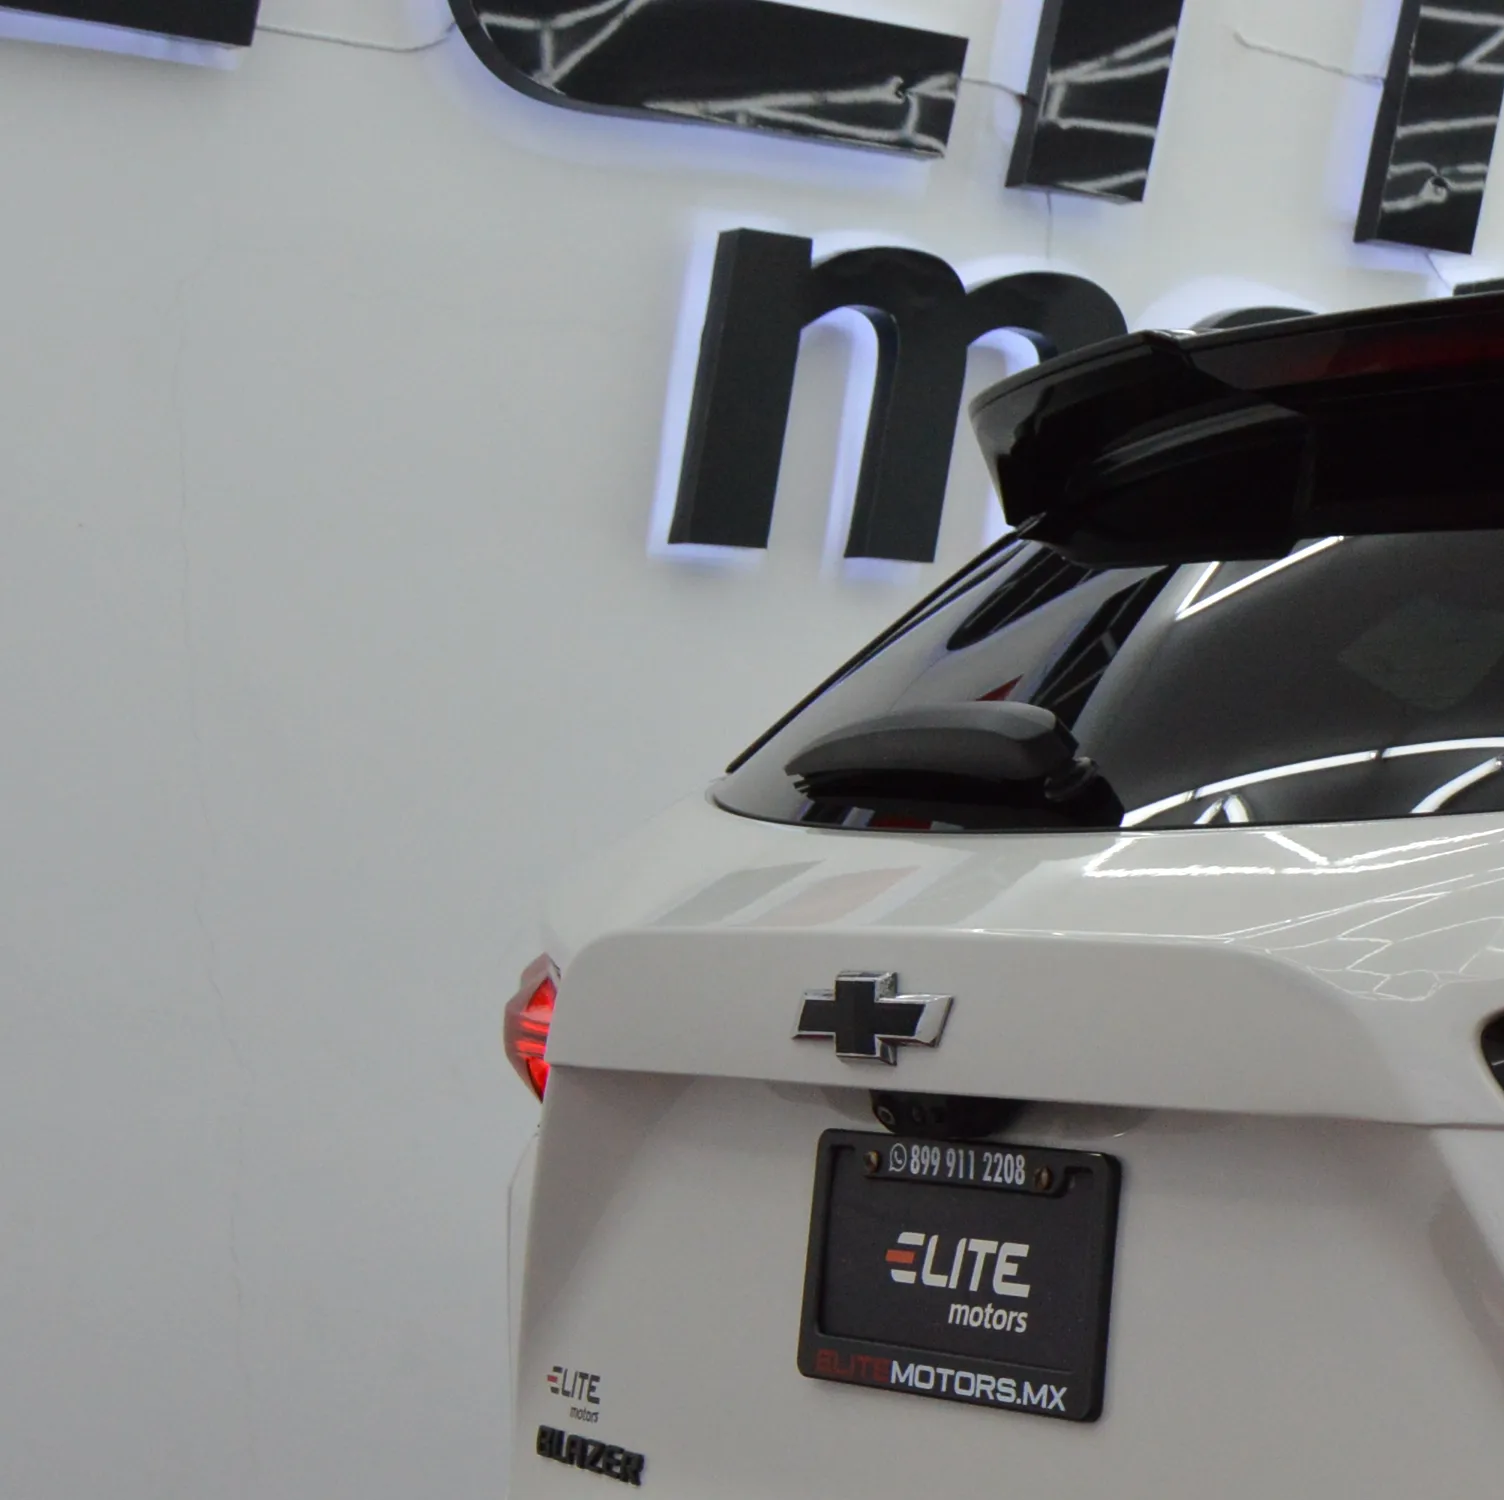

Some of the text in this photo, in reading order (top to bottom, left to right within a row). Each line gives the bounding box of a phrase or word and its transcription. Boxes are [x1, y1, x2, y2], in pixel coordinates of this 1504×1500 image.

[910, 1144, 1025, 1185] 899 911 2208
[886, 1231, 1030, 1298] ELITE
[948, 1302, 1029, 1333] motors
[547, 1366, 600, 1404] ELITE
[569, 1405, 599, 1423] motors
[536, 1424, 645, 1487] BLAZER
